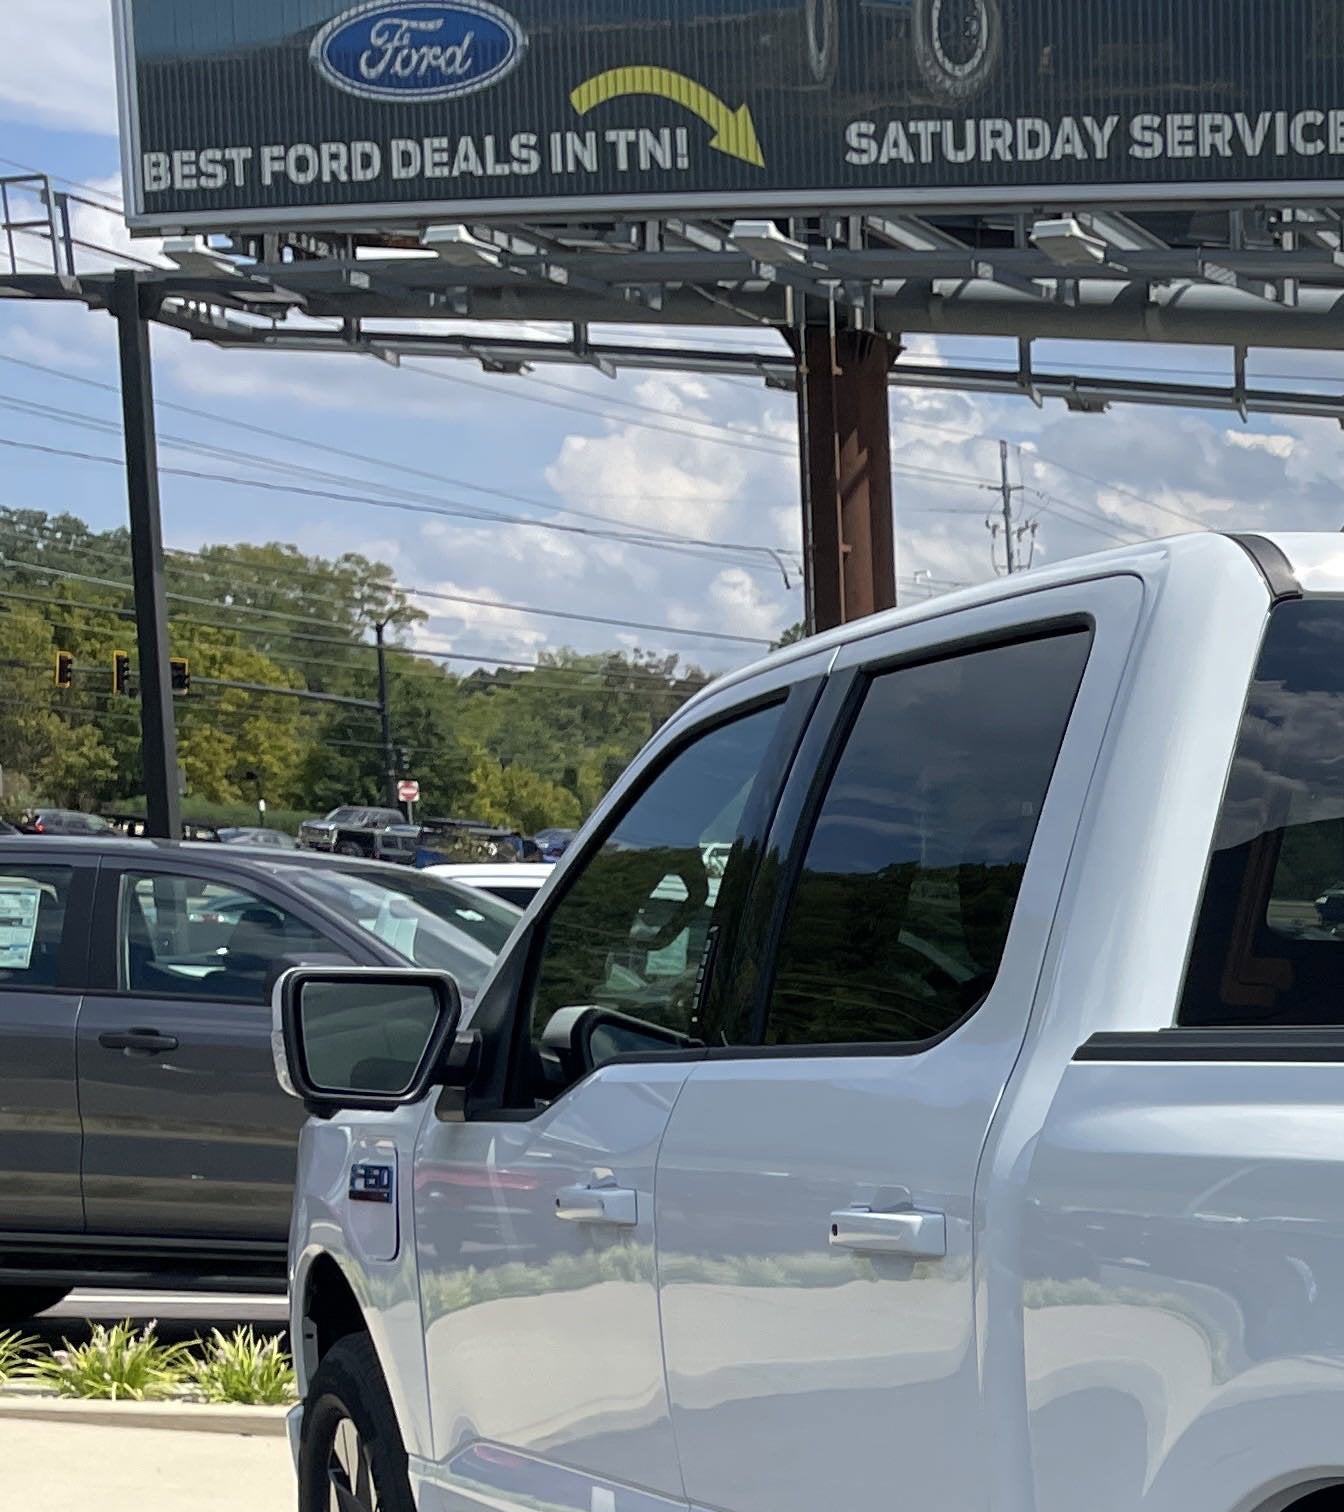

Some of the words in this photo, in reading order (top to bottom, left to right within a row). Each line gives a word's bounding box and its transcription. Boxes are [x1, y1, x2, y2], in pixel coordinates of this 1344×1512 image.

[358, 16, 475, 79] Ford
[143, 146, 253, 193] BEST
[261, 139, 381, 187] FORD
[390, 132, 542, 181] DEALS
[550, 129, 600, 175] IN
[604, 126, 690, 172] TN!
[844, 114, 1123, 166] SATURDAY
